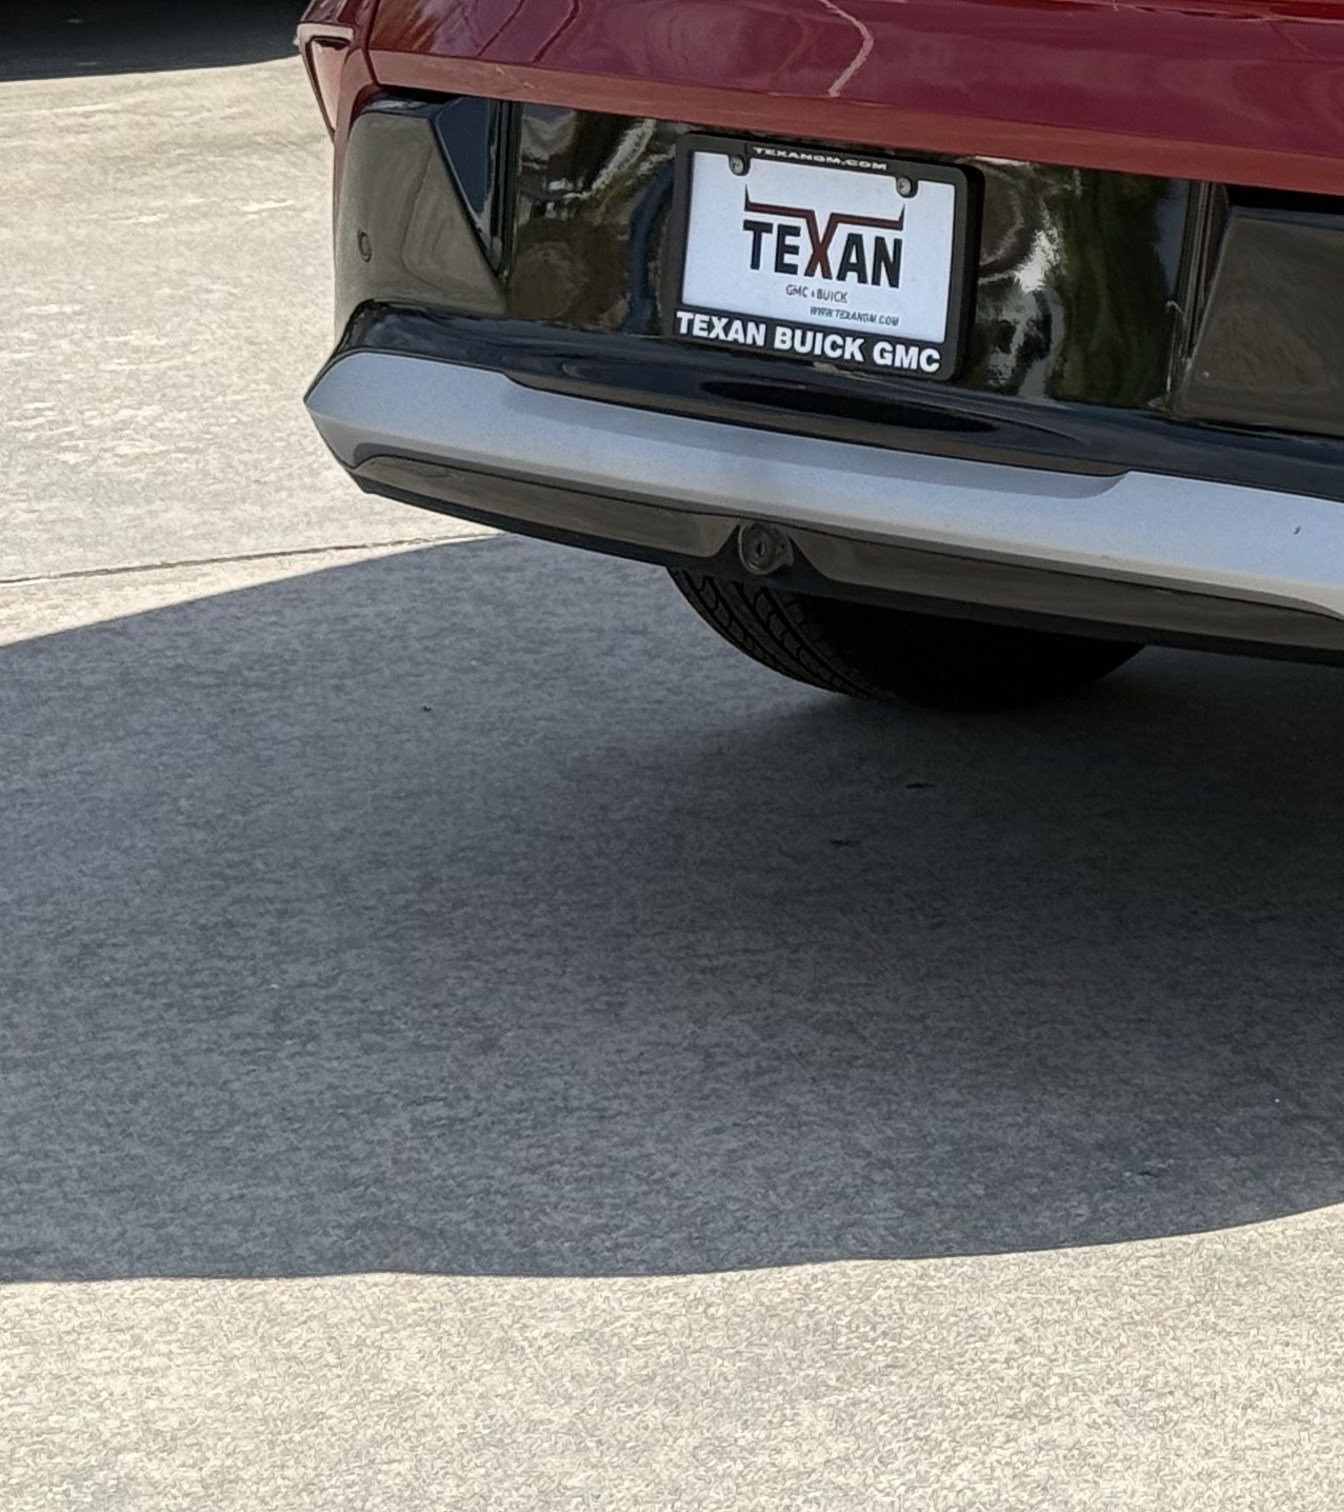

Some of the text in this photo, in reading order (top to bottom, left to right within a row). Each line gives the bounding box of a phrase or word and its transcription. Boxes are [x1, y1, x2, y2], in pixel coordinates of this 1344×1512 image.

[753, 146, 888, 172] TEXANGM.COM
[742, 198, 905, 289] TEXAN
[676, 310, 941, 373] TEXAN BUICK GMC
